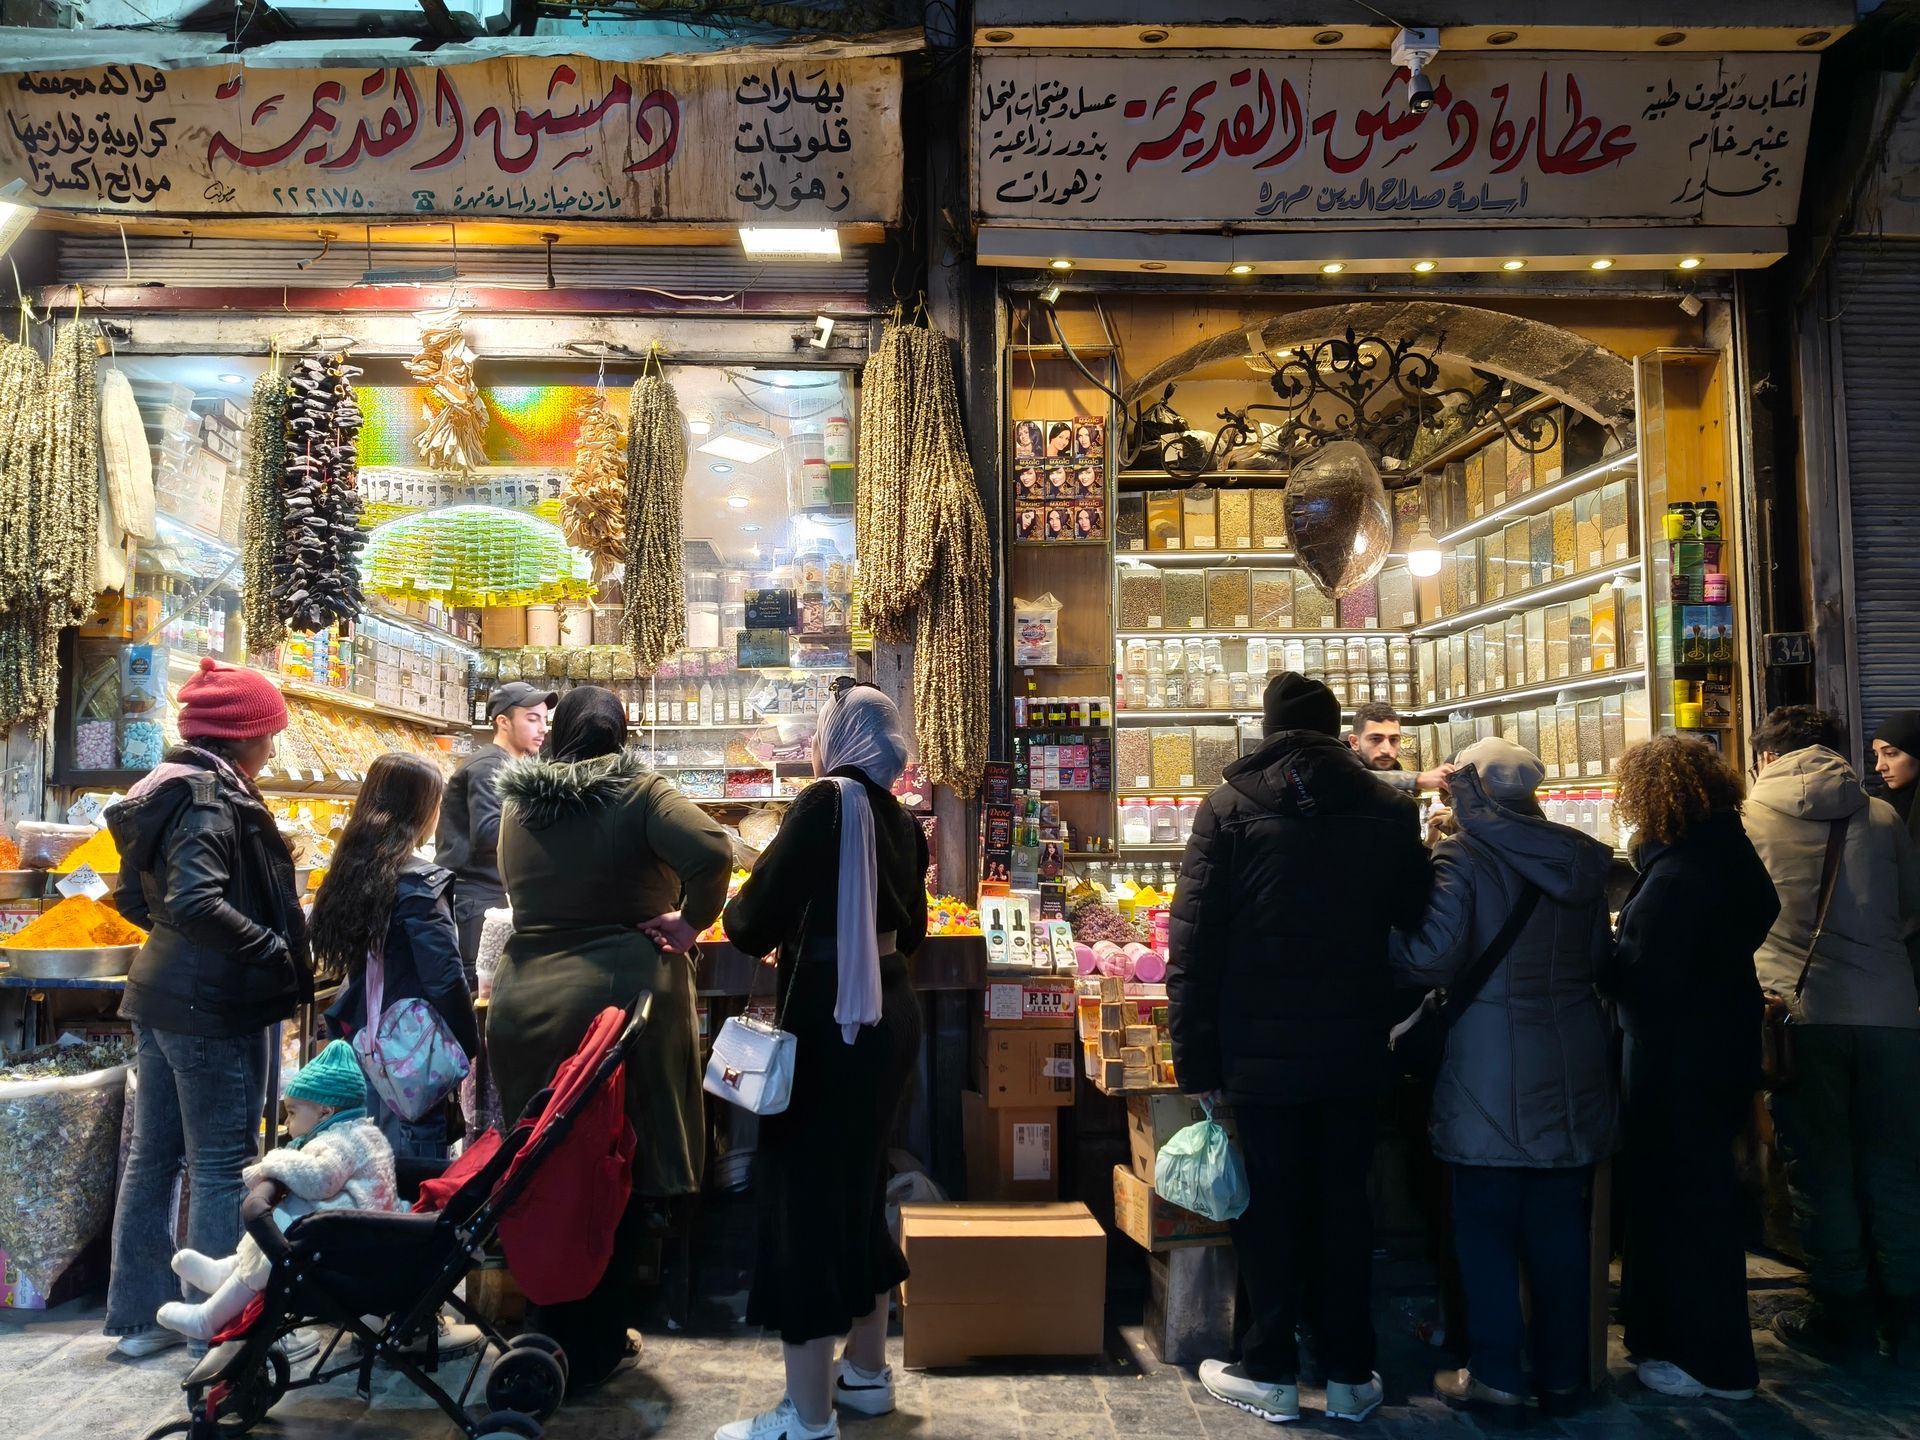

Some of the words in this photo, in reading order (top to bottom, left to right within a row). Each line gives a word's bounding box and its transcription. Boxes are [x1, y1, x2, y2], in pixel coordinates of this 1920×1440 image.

[980, 79, 1016, 126] النحل
[1015, 80, 1069, 125] ومنتجات
[1069, 86, 1117, 120] عسل
[1640, 75, 1682, 121] طبية
[96, 111, 177, 158] كراوية
[207, 67, 464, 173] القديمة
[474, 64, 680, 174] دمشق
[1123, 68, 1303, 174] القديمة
[1489, 71, 1637, 175] عطارة
[988, 123, 1053, 163] زراعية
[1688, 125, 1738, 162] خام
[1735, 125, 1791, 161] عنبر
[105, 162, 172, 204] موالح
[453, 186, 485, 210] مهرة
[537, 185, 577, 214] خباز
[578, 186, 622, 211] مازن
[996, 168, 1103, 206] زهورات
[1316, 178, 1376, 213] الدين
[1375, 178, 1446, 212] صلاح
[1447, 176, 1529, 214] أسامة
[1670, 161, 1783, 205] بخور
[1777, 637, 1805, 662] 34
[1029, 992, 1062, 1006] RED
[1032, 1005, 1059, 1013] JELLY
